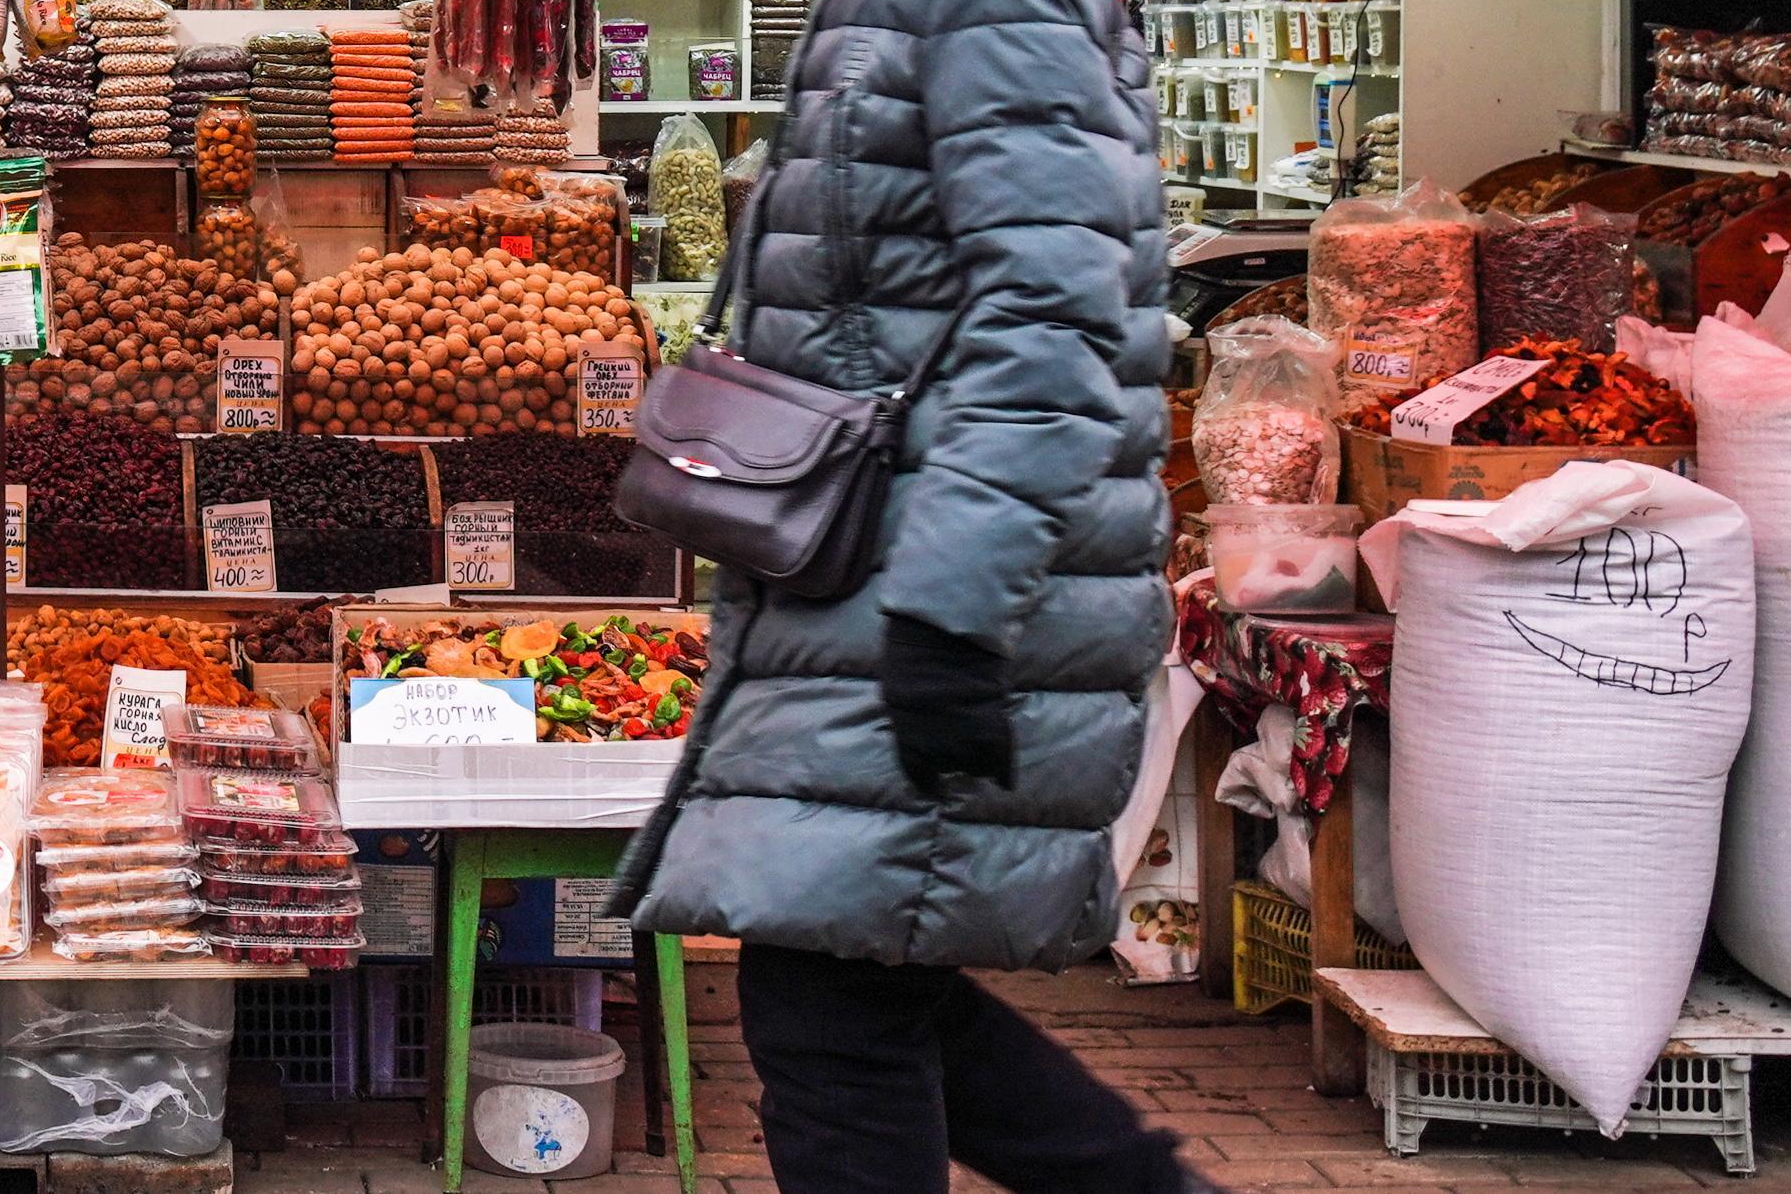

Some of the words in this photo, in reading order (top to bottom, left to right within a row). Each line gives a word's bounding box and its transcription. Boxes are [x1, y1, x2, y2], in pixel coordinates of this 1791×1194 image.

[612, 69, 641, 77] ЧАБРЕЦ
[703, 73, 732, 81] ЧАБРЕЦ
[0, 253, 17, 262] Rice
[233, 358, 263, 370] ОРЕХ
[233, 379, 264, 390] ЧИЛИ
[209, 515, 265, 529] ШИПОВНИК
[406, 683, 458, 701] НАБОР
[118, 692, 161, 708] КУРАГА
[392, 703, 497, 731] ЭКЗОТИК
[113, 718, 147, 732] КИСЛО
